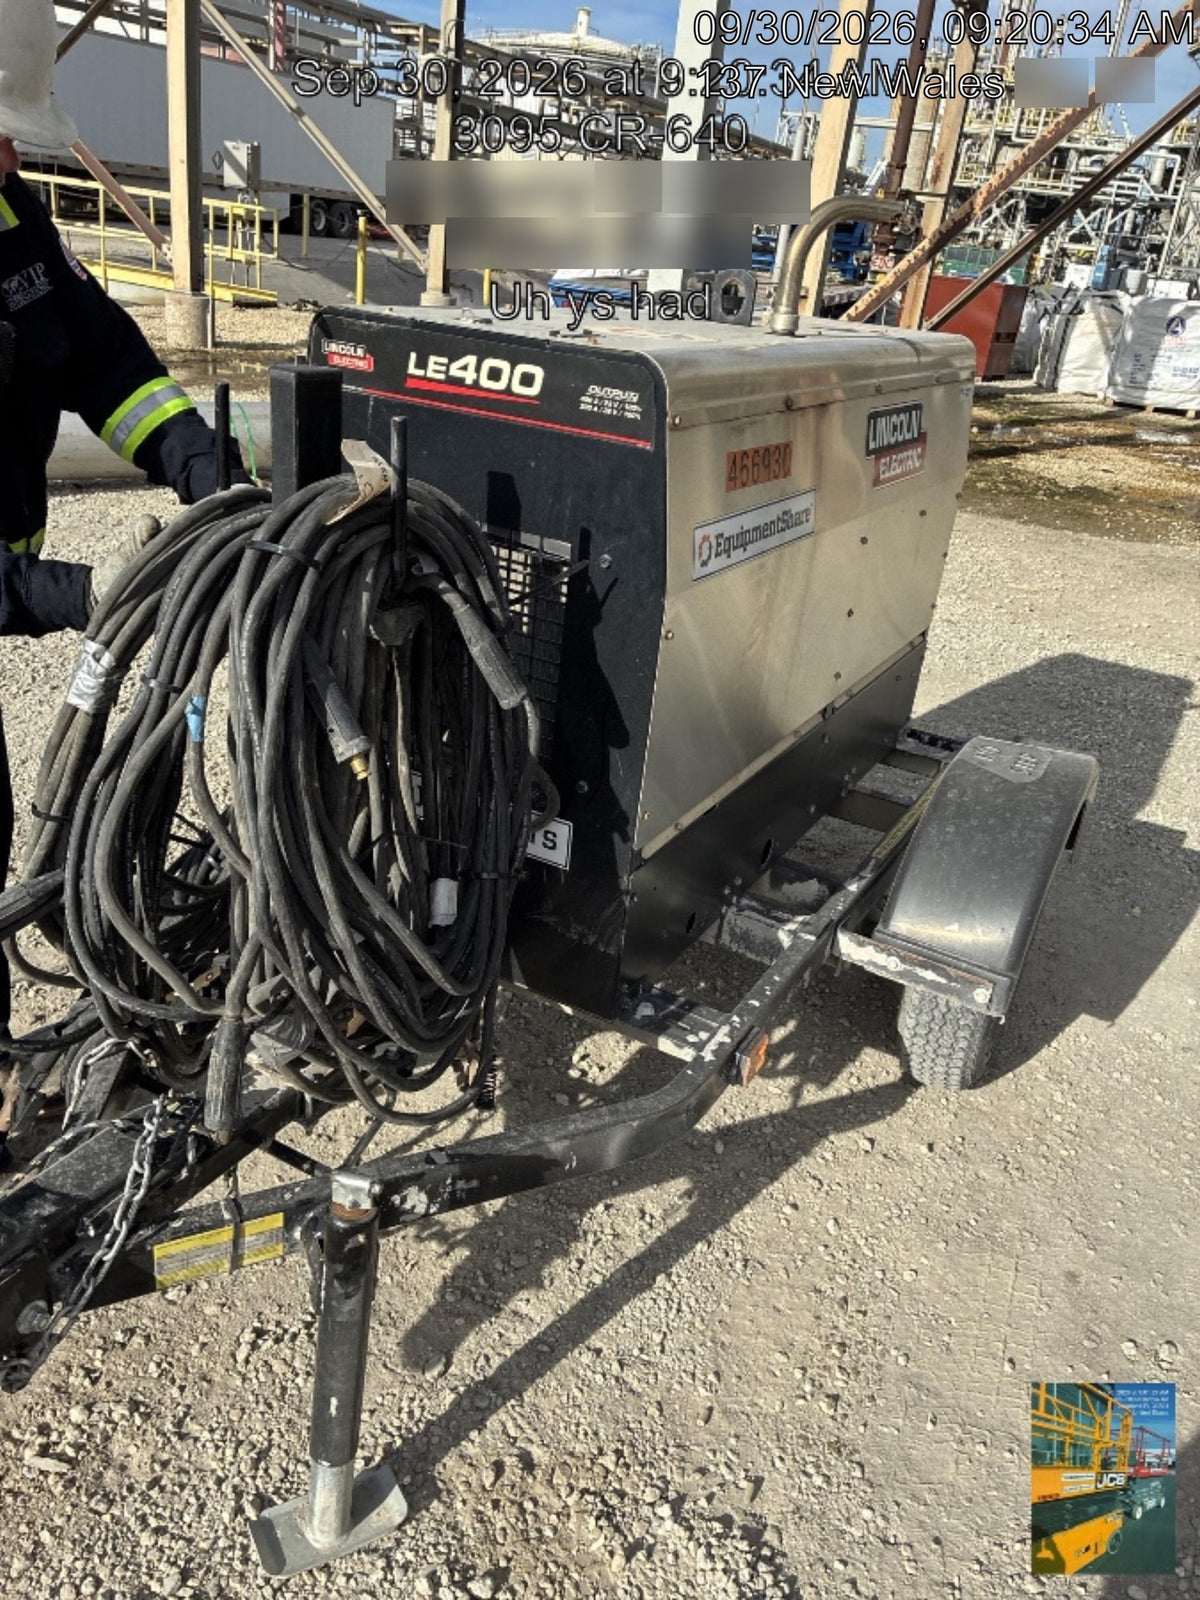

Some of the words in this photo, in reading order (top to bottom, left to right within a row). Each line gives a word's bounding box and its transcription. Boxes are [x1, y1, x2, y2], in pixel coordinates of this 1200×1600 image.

[406, 351, 545, 397] LE400
[869, 409, 921, 451] LINCOLN
[714, 507, 811, 558] EquipmentShare
